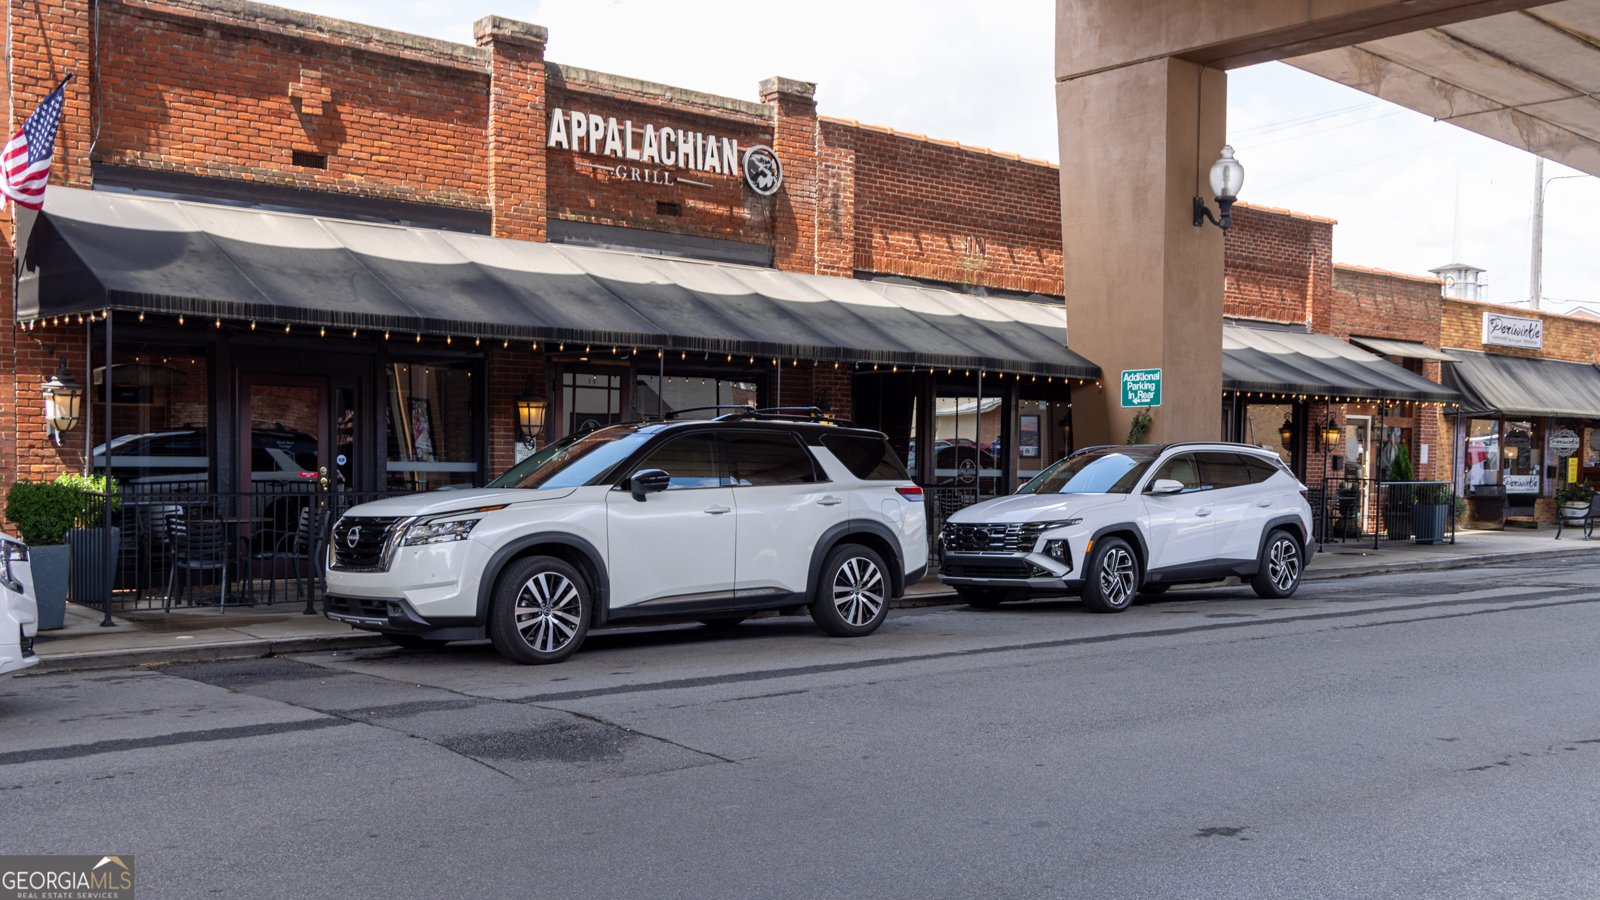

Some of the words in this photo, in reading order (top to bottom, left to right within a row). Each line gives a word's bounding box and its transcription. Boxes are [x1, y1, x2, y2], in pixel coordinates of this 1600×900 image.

[547, 107, 739, 176] APPALACHIAN
[615, 164, 675, 186] GRILL
[1489, 318, 1540, 339] Periwinkle
[1123, 371, 1160, 381] Additional
[1127, 382, 1155, 391] Parking
[1128, 391, 1135, 399] In
[1137, 390, 1155, 399] Rear
[1504, 476, 1538, 488] Periwinkle
